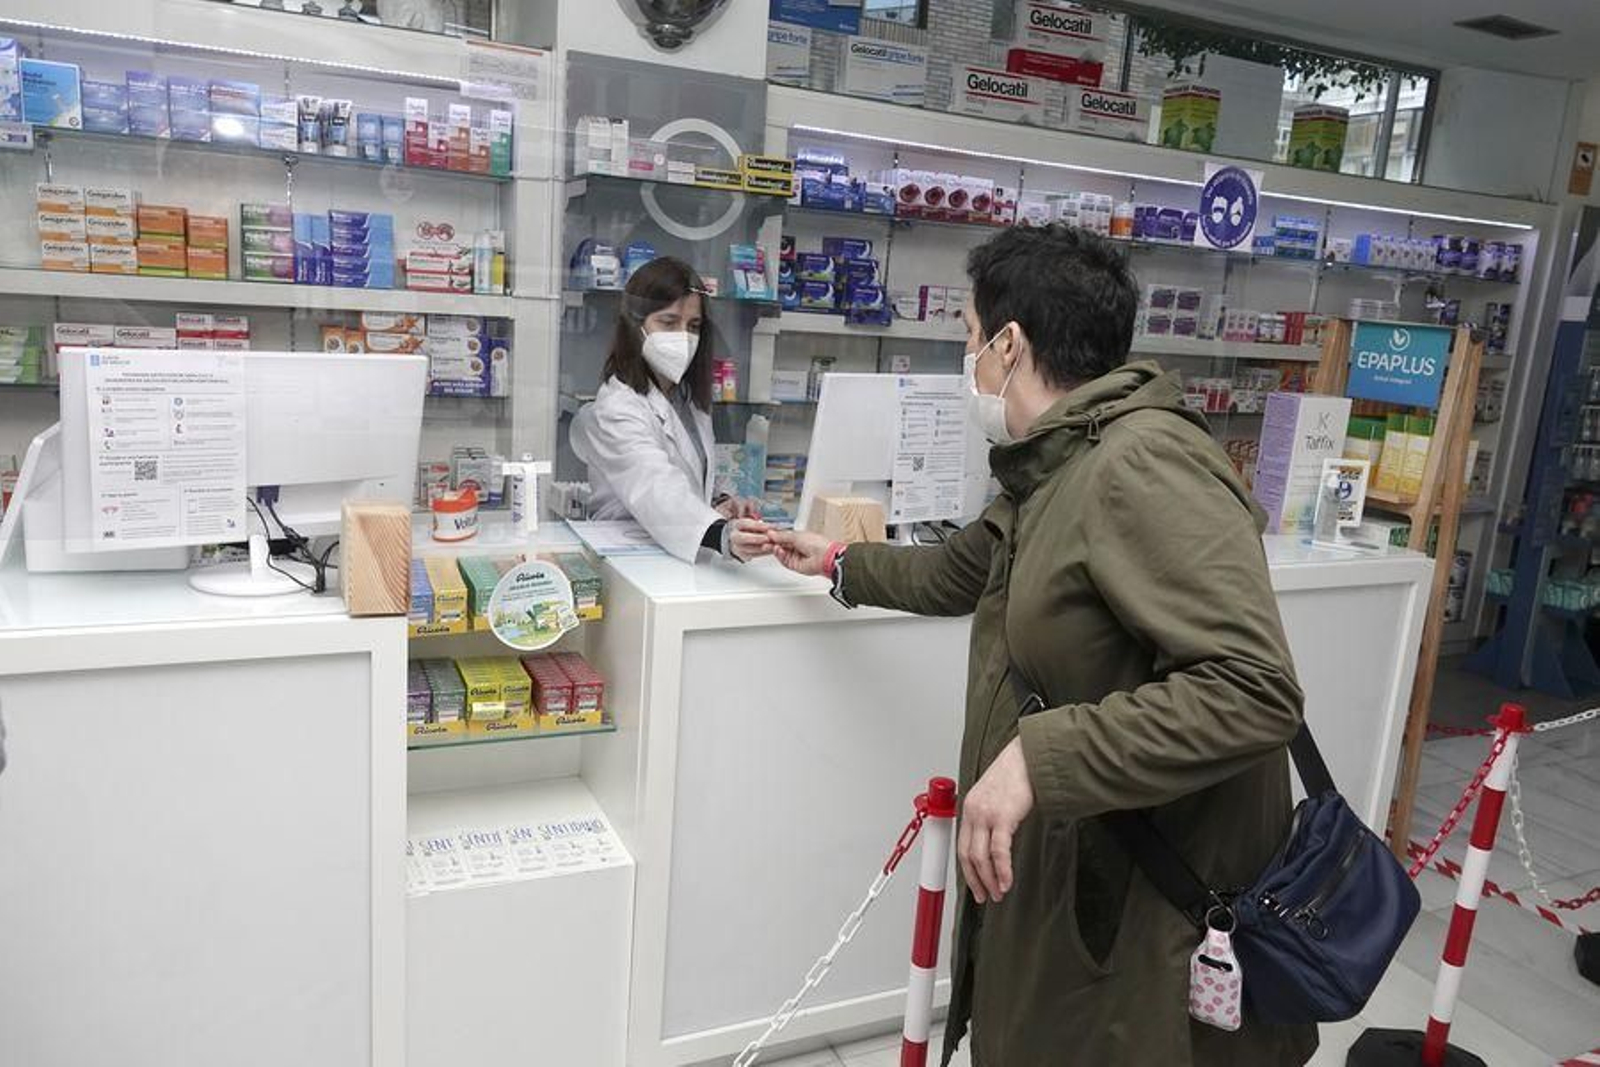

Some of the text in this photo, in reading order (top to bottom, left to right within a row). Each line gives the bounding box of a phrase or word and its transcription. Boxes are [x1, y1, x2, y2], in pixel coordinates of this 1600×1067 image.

[1030, 9, 1092, 34] Gelocatil
[851, 43, 887, 57] Gelocatil
[967, 74, 1028, 97] Gelocatil
[1081, 94, 1137, 116] Gelocatil
[1357, 350, 1437, 376] EPAPLUS
